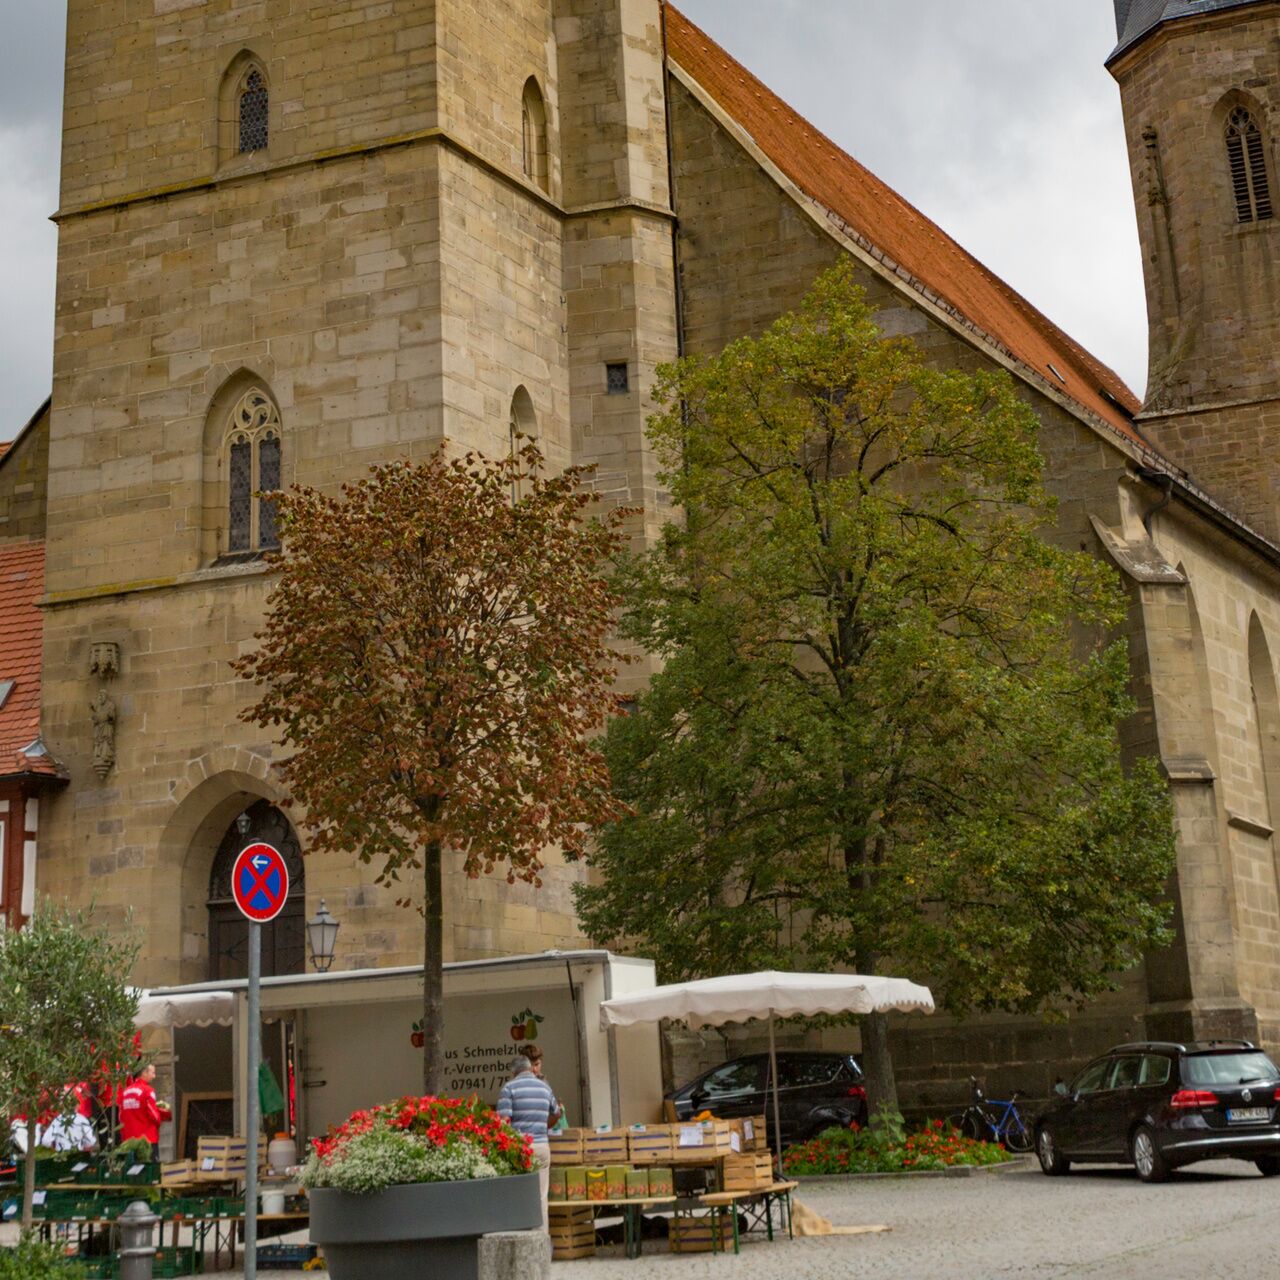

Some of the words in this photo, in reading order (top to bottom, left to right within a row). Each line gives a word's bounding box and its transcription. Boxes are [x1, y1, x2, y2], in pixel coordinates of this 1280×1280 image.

[445, 1049, 459, 1060] us
[443, 1060, 513, 1076] r.-Verrenbe
[451, 1077, 486, 1091] 07941
